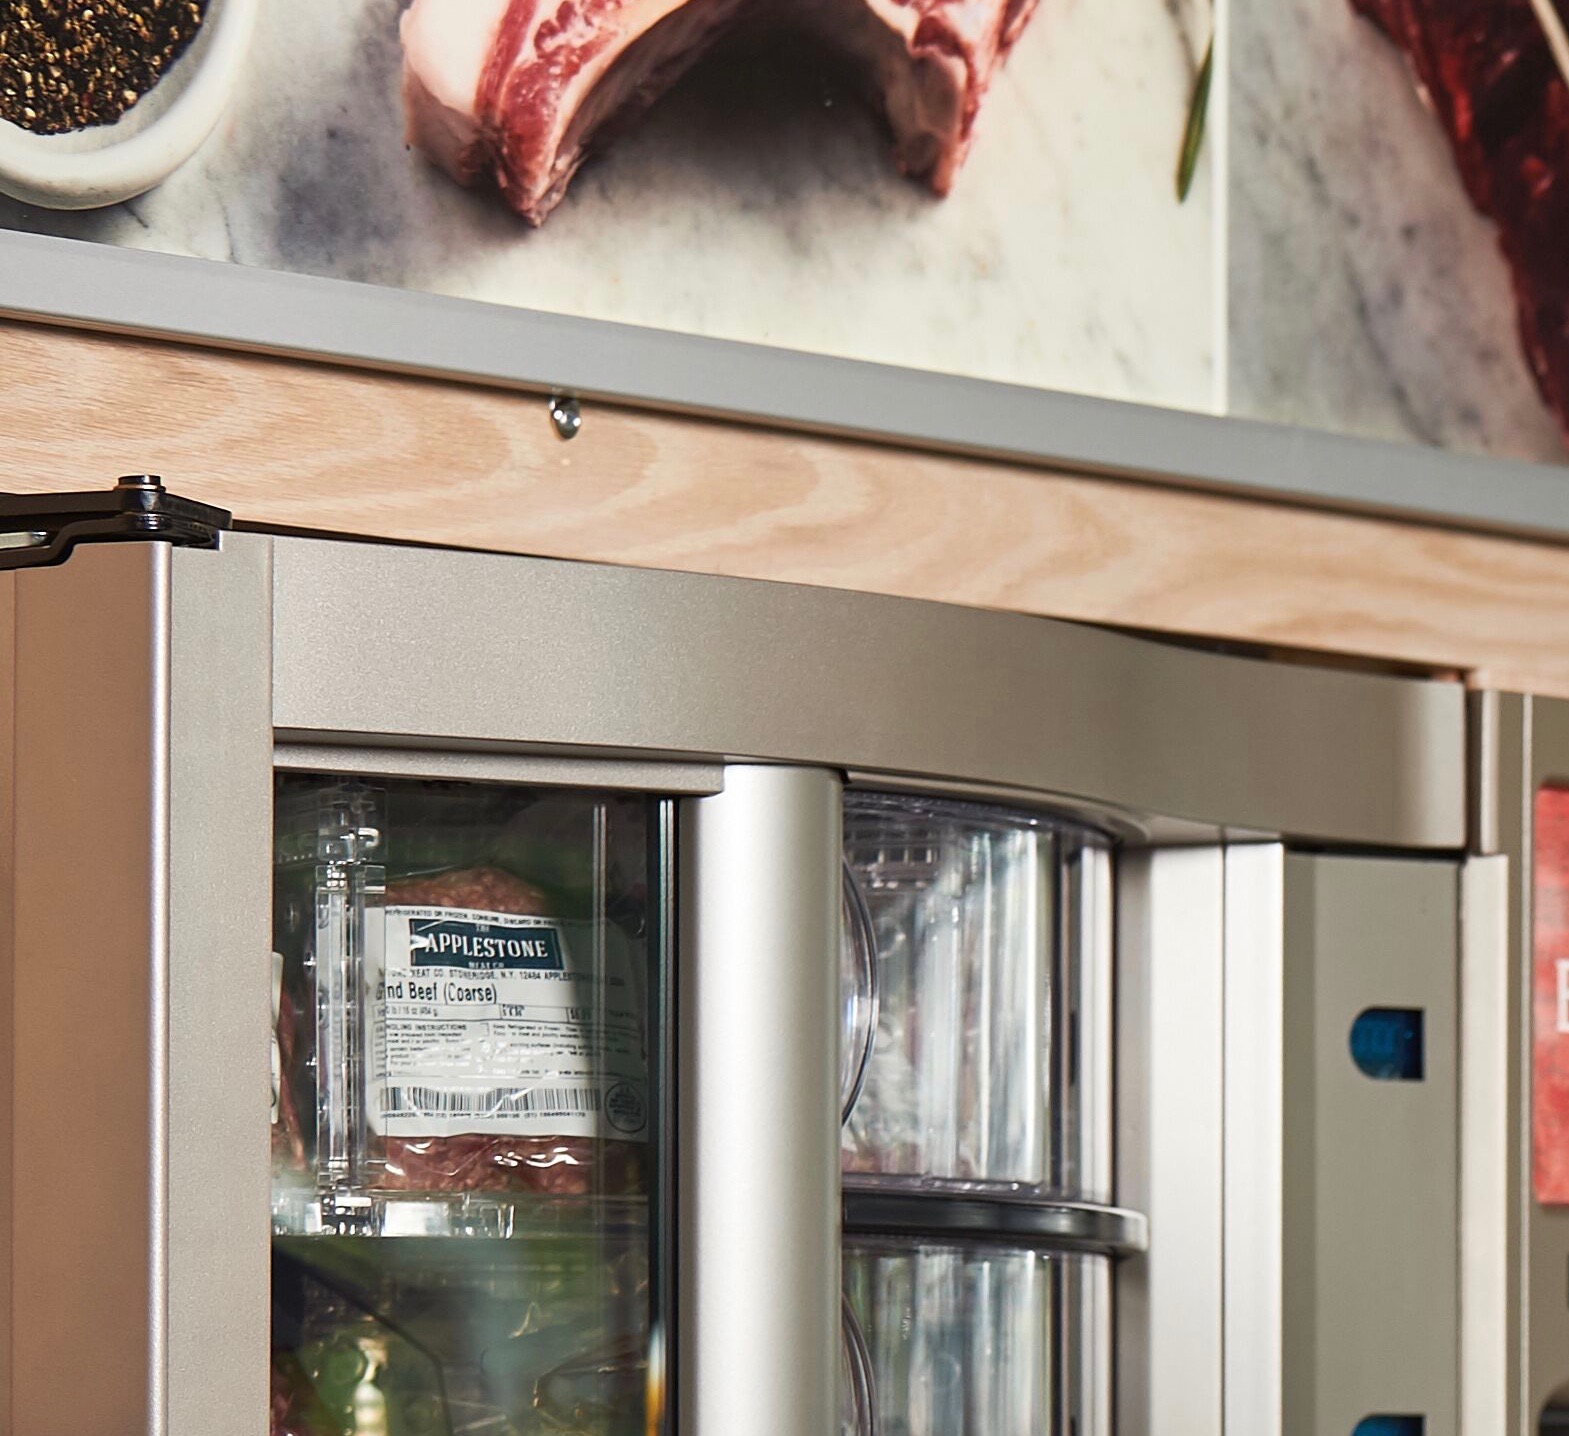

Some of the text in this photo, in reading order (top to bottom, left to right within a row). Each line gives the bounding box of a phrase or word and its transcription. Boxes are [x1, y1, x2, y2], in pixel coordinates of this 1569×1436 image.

[425, 932, 548, 958] APPLESTONE
[408, 981, 438, 1001] Beef
[443, 981, 497, 1006] (Coarse)
